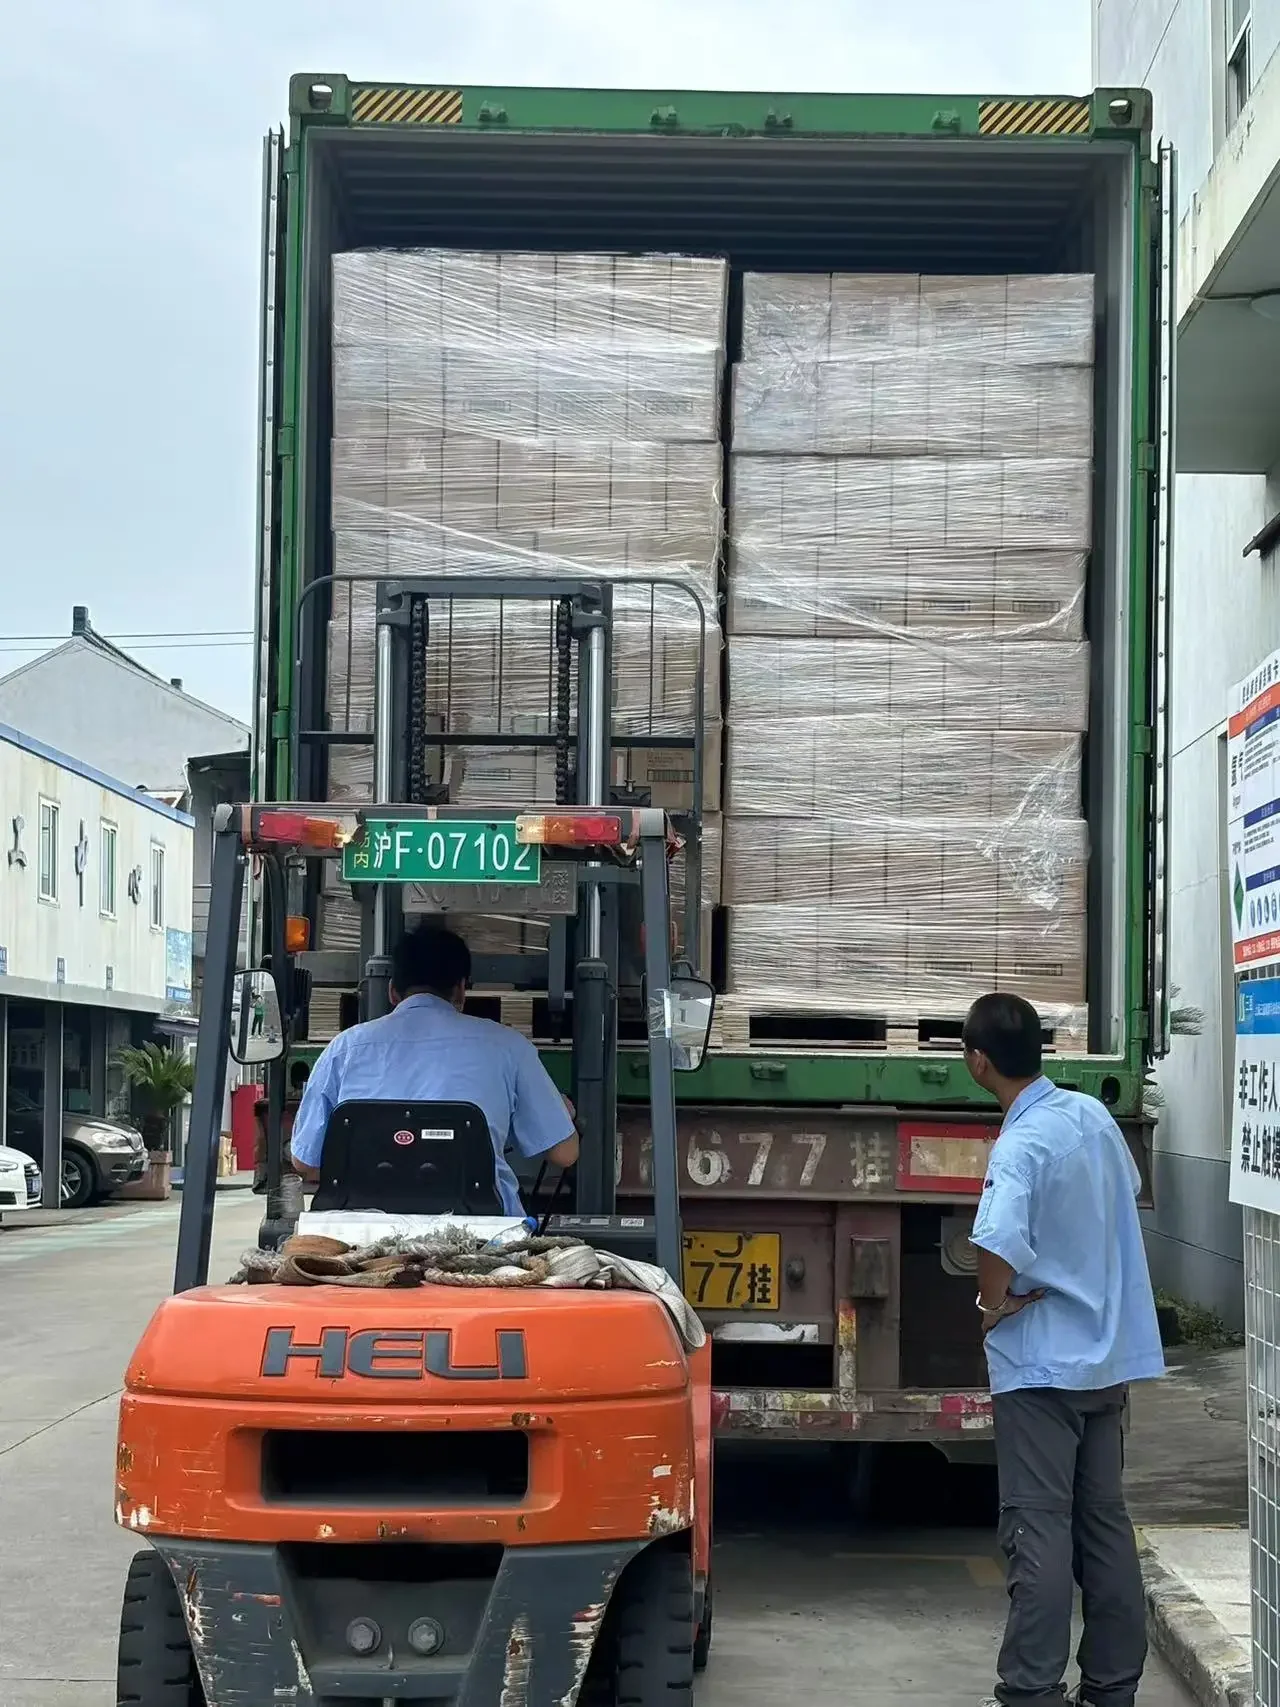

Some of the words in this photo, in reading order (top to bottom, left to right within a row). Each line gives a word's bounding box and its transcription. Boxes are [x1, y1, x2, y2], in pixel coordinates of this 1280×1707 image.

[1238, 1059, 1280, 1113] 非工作人
[260, 1326, 529, 1381] HELI
